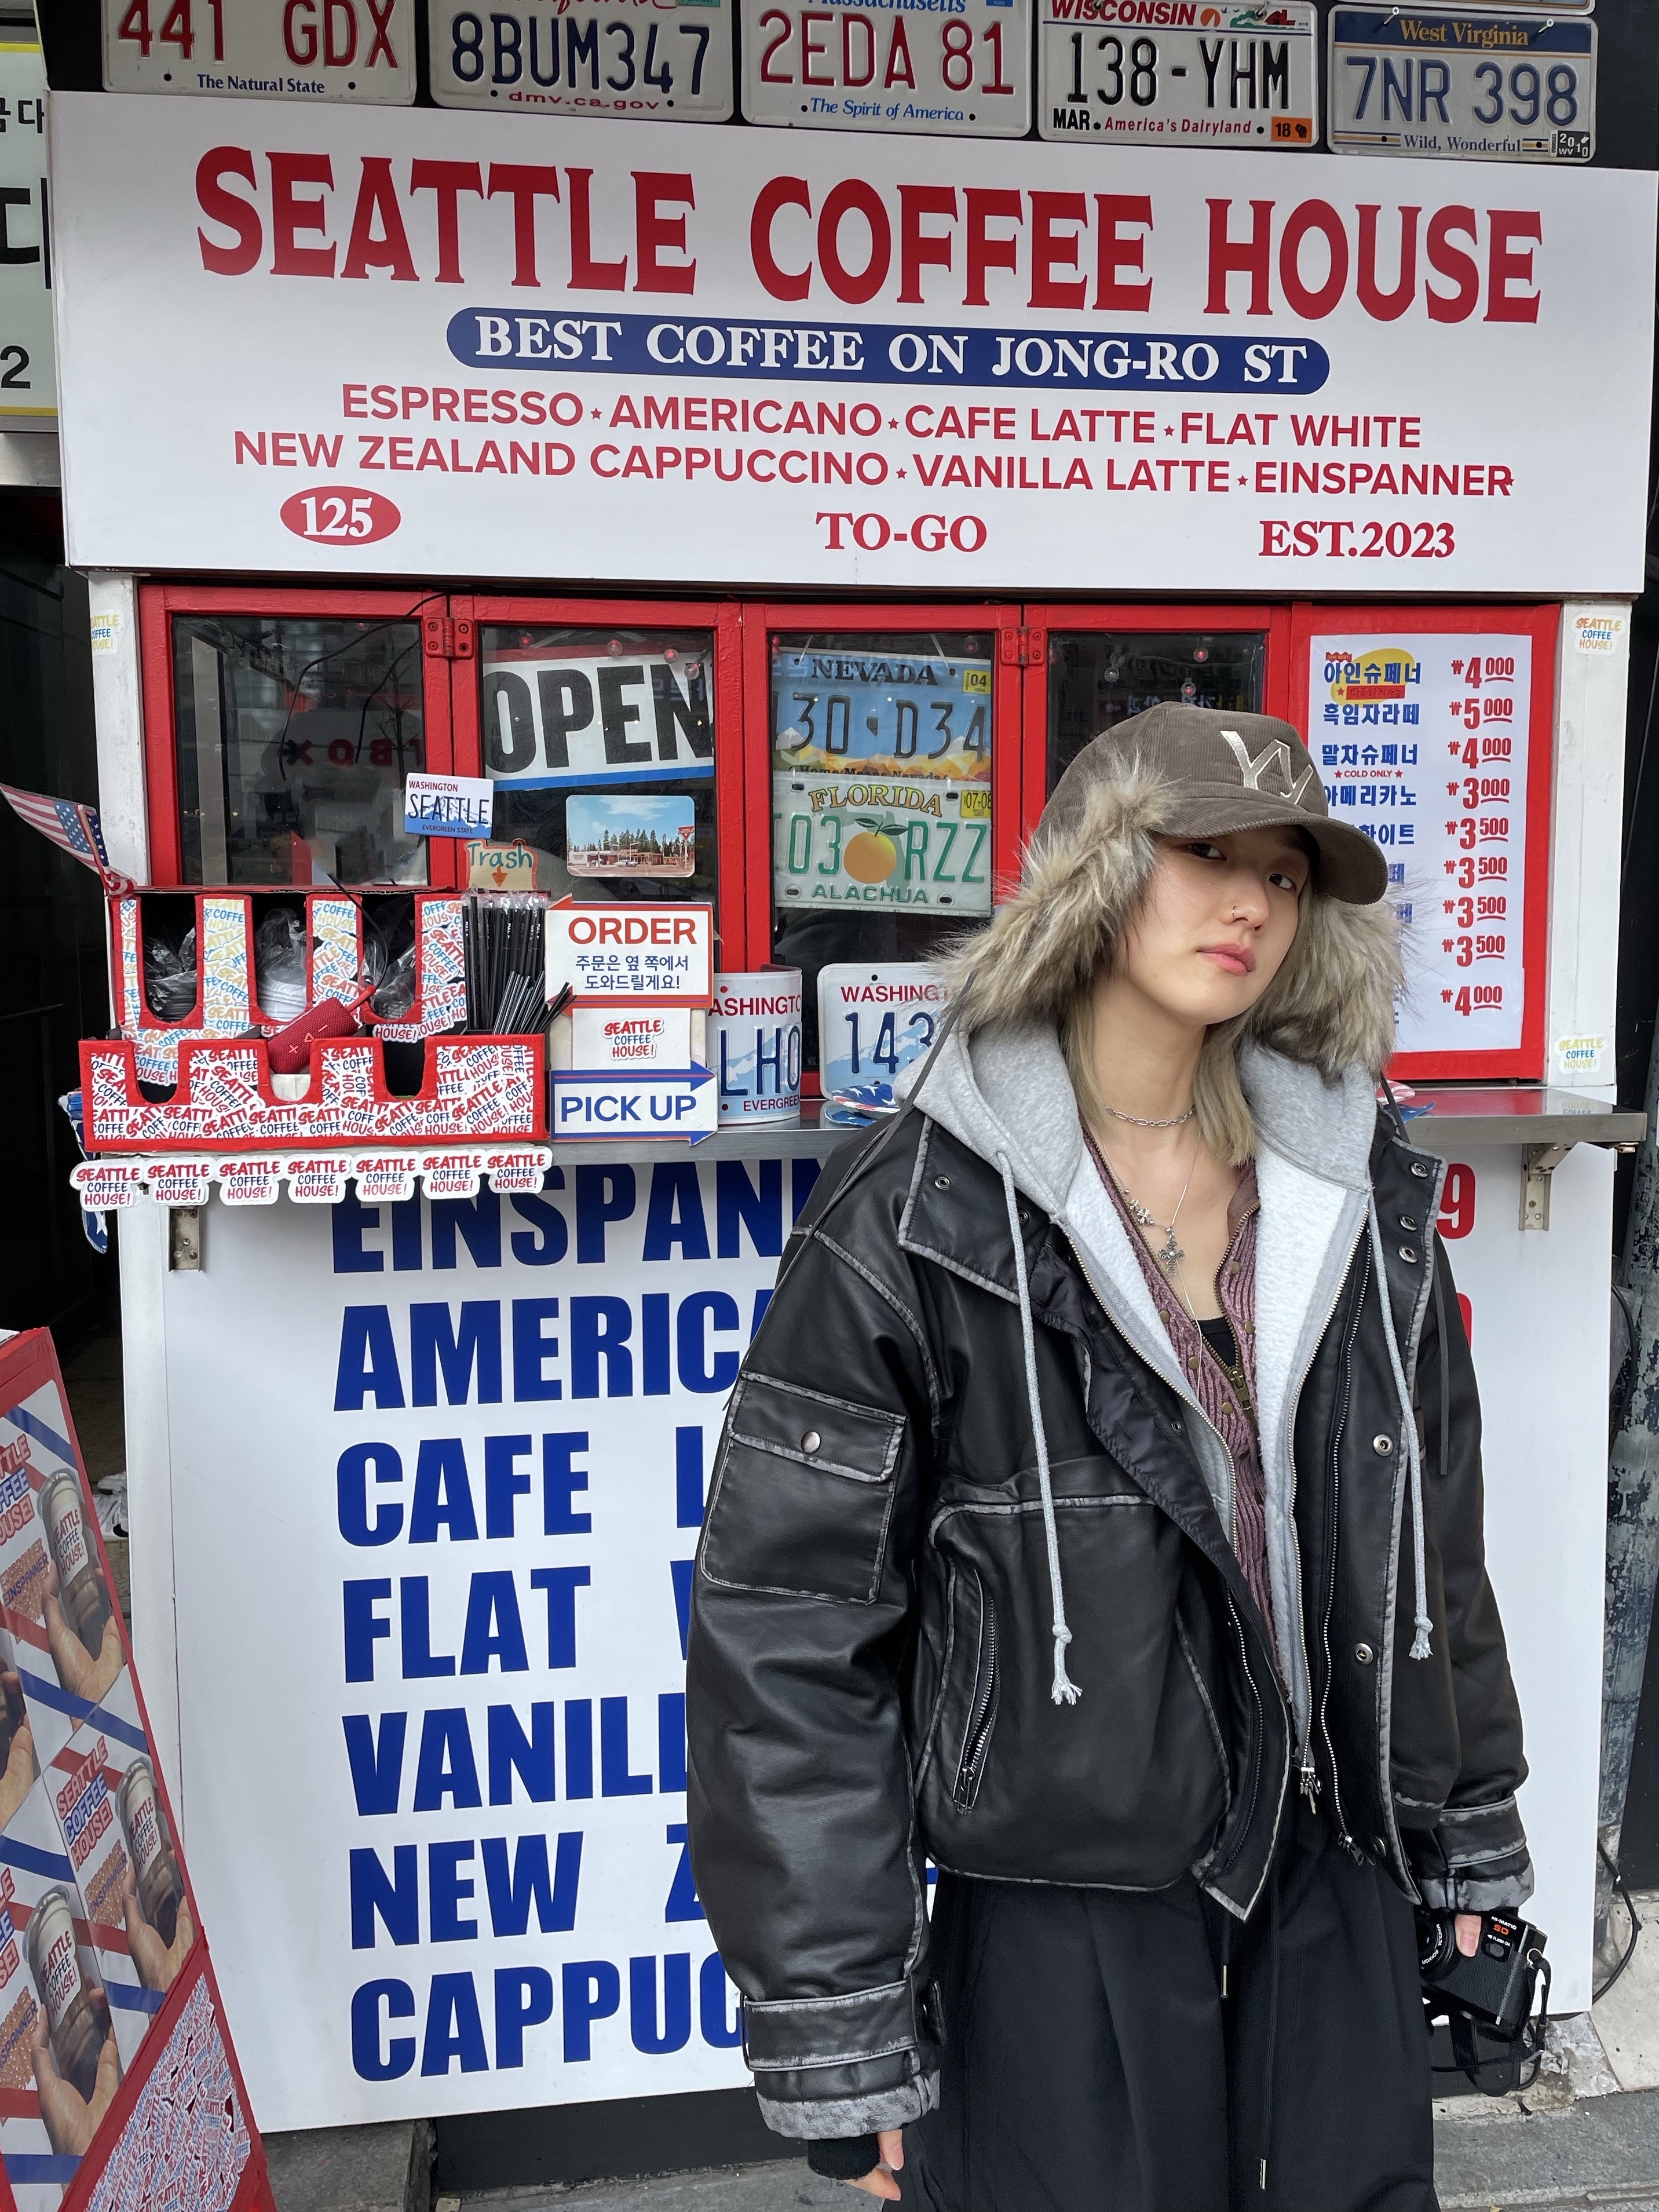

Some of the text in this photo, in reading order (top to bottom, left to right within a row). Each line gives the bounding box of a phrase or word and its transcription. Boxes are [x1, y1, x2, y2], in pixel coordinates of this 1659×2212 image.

[1051, 0, 1196, 25] WISCONSIN
[118, 0, 399, 69] 441 GDX
[1399, 20, 1528, 49] West Virginia
[452, 12, 710, 96] 8BUM347
[760, 9, 1014, 94] 2EDA 81
[1068, 32, 1290, 109] 138-YHM
[197, 74, 326, 94] The Natural State
[1347, 57, 1577, 126] 7NR 398
[509, 92, 659, 109] dmv.ca.gov
[811, 97, 963, 121] The Spirit of America
[1053, 108, 1090, 131] MAR
[1105, 116, 1251, 137] America's Dairyland
[1275, 123, 1291, 137] 18
[1404, 135, 1521, 153] Wild, Wonderful
[195, 146, 696, 294] SEATTLE
[750, 176, 1153, 313] COFFEE
[1203, 198, 1542, 324] HOUSE
[475, 315, 1307, 384] BEST COFFEE ON JONG-RO ST
[342, 383, 1421, 448] ESPRESSO AMERICANO CAFE LATTE FLAT WHITE
[235, 431, 1511, 497] NEW ZEALAND CAPPUCCINO VANILLA LATTE EINSPANNER
[300, 497, 375, 538] 125
[816, 512, 987, 553] TO-GO
[1259, 520, 1456, 558] EST.2023
[1576, 618, 1621, 632] SEATTLE
[1579, 638, 1613, 650] HOUSE!
[1582, 630, 1612, 640] COFFEE
[812, 658, 938, 686] NEVADA
[971, 674, 986, 687] 04
[1324, 662, 1421, 684] 아인슈페너
[483, 662, 714, 773] OPEN
[1324, 703, 1419, 725] 흑임자라떼
[1322, 744, 1418, 766] 말차슈페너
[1344, 770, 1393, 778] COLD ONLY
[409, 780, 458, 792] WASHINGTON
[409, 793, 489, 824] SEATTLE
[809, 784, 942, 817] FLORIDA
[422, 824, 473, 834] EVERGREEN STATE
[466, 842, 533, 868] Trash
[904, 820, 987, 884] RZZ
[812, 883, 928, 904] ALACHUA
[568, 917, 697, 944] ORDER
[575, 955, 688, 972] 주문은 옆 쪽에서
[585, 974, 680, 990] 도와드릴게요!
[375, 1027, 418, 1043] HOUSE!
[604, 1019, 664, 1036] SEATTLE
[614, 1034, 652, 1046] COFFEE
[1559, 1036, 1603, 1051] SEATTLE
[612, 1045, 654, 1058] HOUSE!
[1566, 1049, 1595, 1059] COFFEE
[1564, 1058, 1597, 1069] HOUSE!
[452, 1079, 503, 1122] SEATTLE
[561, 1095, 697, 1122] PICK UP
[466, 1098, 500, 1125] COFFEE
[470, 1104, 510, 1135] HOUSE!
[219, 1160, 280, 1177] SEATTLE
[288, 1159, 347, 1174] SEATTLE
[356, 1158, 416, 1173] SEATTLE
[423, 1155, 481, 1170] SEATTLE
[487, 1153, 545, 1168] SEATTLE
[76, 1167, 140, 1182] SEATTLE
[147, 1163, 210, 1179] SEATTLE
[298, 1173, 336, 1185] COFFEE
[366, 1173, 404, 1184] COFFEE
[433, 1169, 470, 1180] COFFEE
[497, 1167, 535, 1178] COFFEE
[87, 1181, 128, 1193] COFFEE
[158, 1178, 198, 1189] COFFEE
[229, 1176, 269, 1187] COFFEE
[363, 1183, 407, 1196] HOUSE!
[429, 1180, 473, 1193] HOUSE!
[494, 1178, 537, 1188] HOUSE!
[85, 1192, 130, 1205] HOUSE!
[155, 1188, 201, 1202] HOUSE!
[226, 1186, 272, 1199] HOUSE!
[295, 1184, 338, 1198] HOUSE!
[337, 1431, 592, 1547] CAFE
[343, 1565, 591, 1682] FLAT
[56, 1736, 108, 1820] SEATTLE
[64, 1770, 108, 1846] COFFEE
[71, 1797, 113, 1872] HOUSE!
[349, 1831, 584, 1950] NEW
[1493, 1924, 1509, 1935] SD
[48, 1953, 71, 1999] COFFEE
